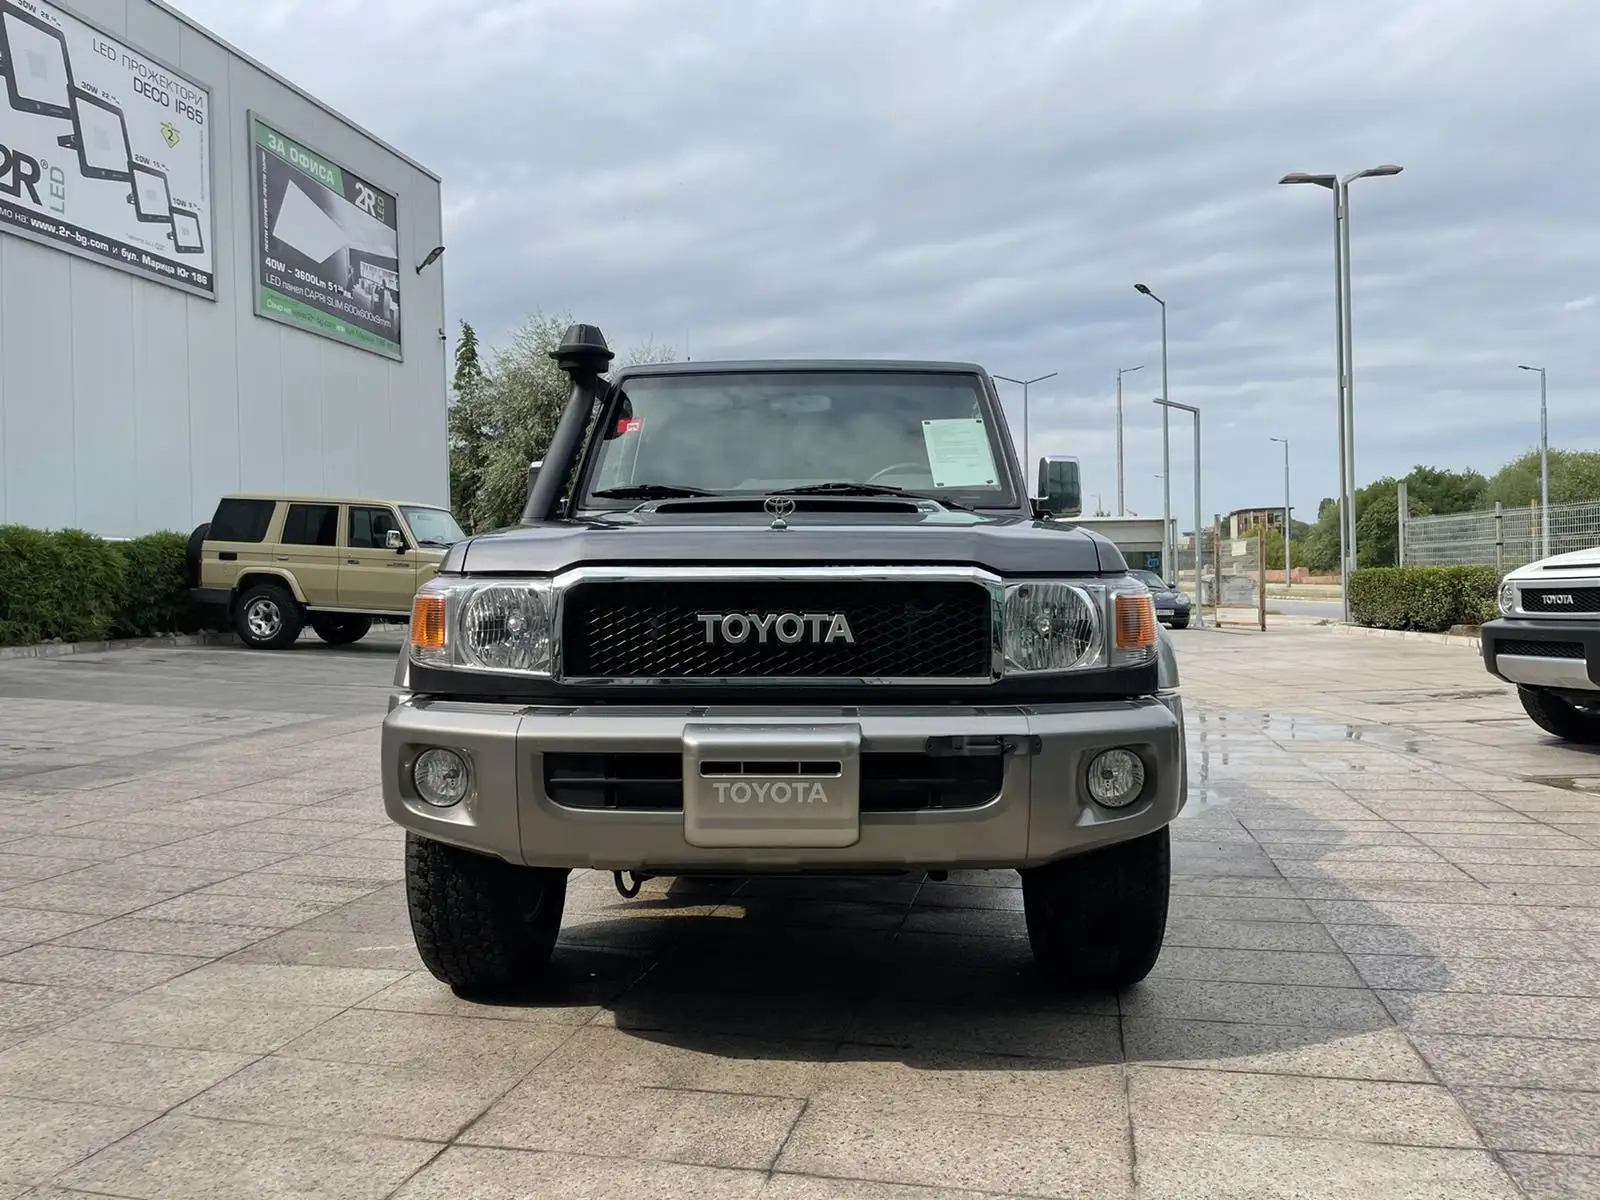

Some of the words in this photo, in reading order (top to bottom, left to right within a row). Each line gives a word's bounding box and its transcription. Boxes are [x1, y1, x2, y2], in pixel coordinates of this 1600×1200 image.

[92, 38, 117, 61] LED
[122, 54, 203, 109] ПРОЖЕКТОРИ
[133, 76, 170, 107] DECO
[175, 100, 204, 125] IP65
[268, 133, 286, 156] ЗА
[290, 147, 335, 185] ОФИСА
[50, 165, 65, 215] LED
[354, 182, 377, 217] 2R
[30, 218, 109, 251] www.2r-bg.com
[142, 254, 175, 273] Марица
[265, 257, 286, 273] 40W
[294, 268, 327, 289] 3600Lm
[265, 273, 281, 286] LED
[1541, 594, 1574, 605] TOYOTA
[697, 613, 855, 644] TOYOTA
[712, 782, 828, 804] TOYOTA
